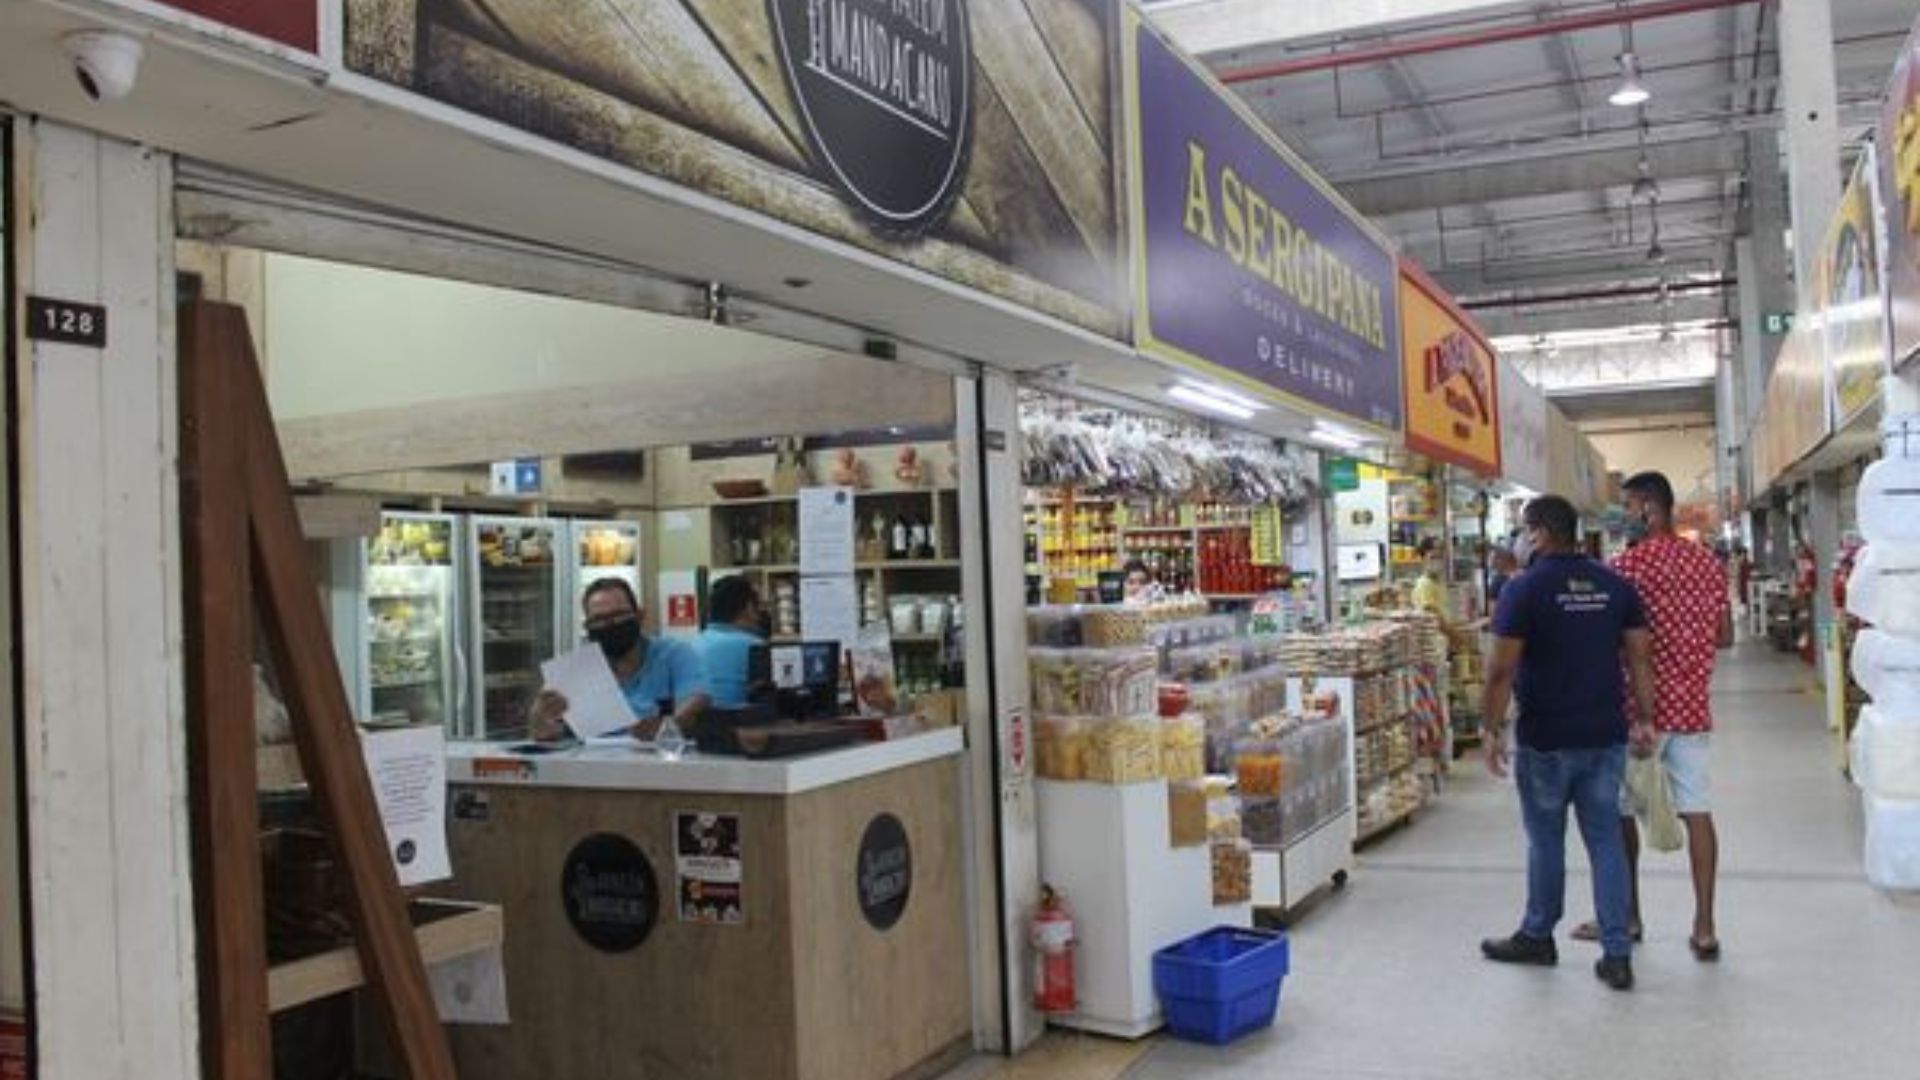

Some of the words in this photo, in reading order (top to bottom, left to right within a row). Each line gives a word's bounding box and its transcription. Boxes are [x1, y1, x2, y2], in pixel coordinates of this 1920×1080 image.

[831, 0, 950, 128] MANDACARU
[1184, 141, 1217, 246] A
[1222, 167, 1386, 350] SERGIPANA
[44, 308, 94, 335] 128
[1257, 335, 1355, 397] DELIVERY
